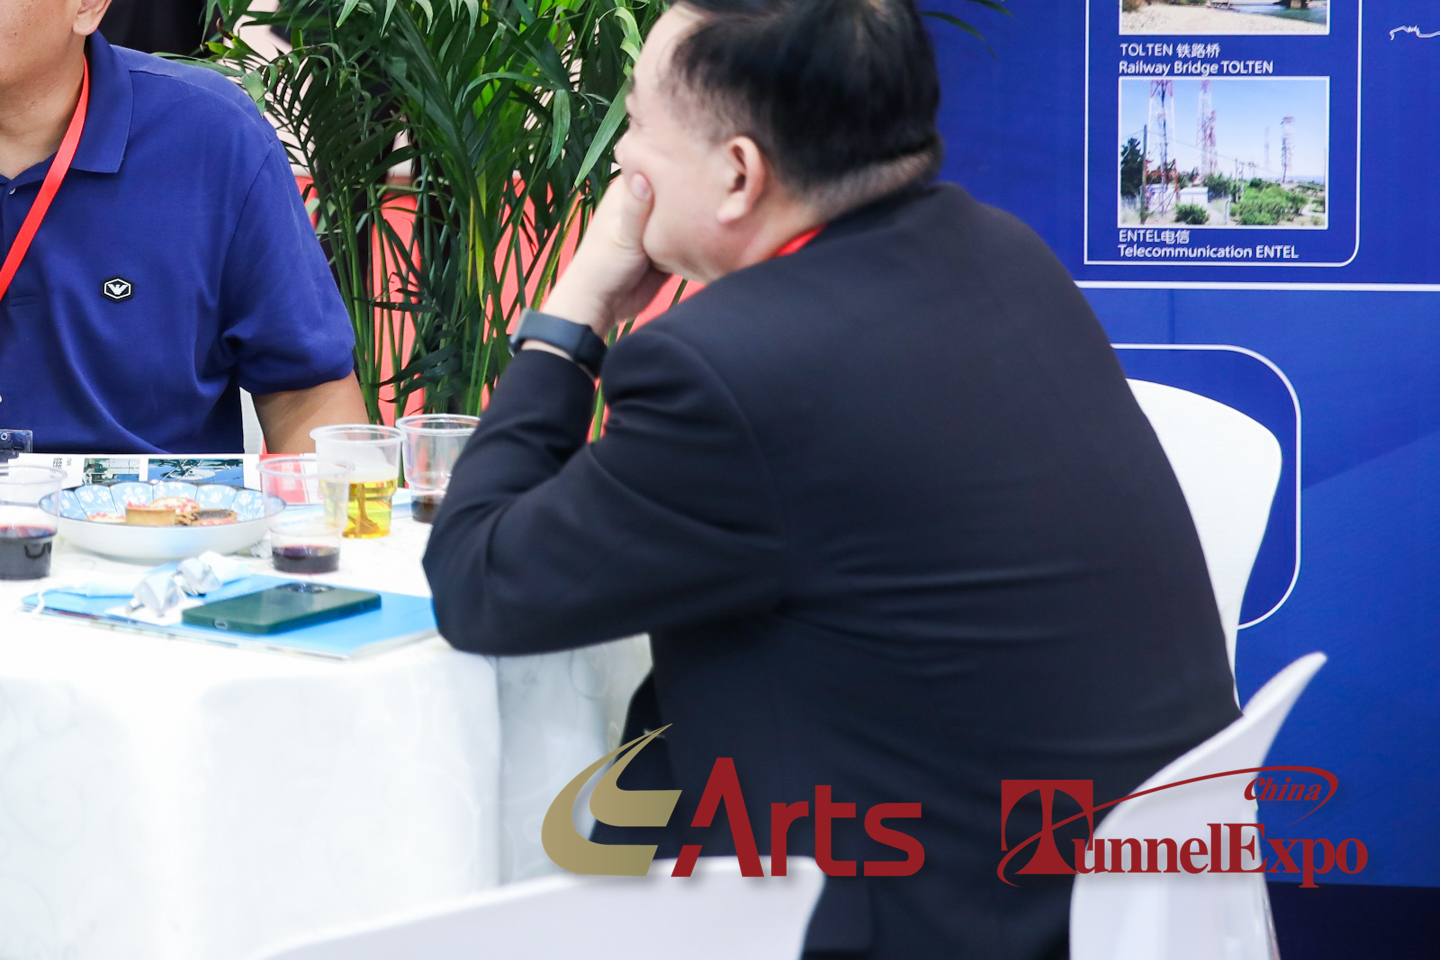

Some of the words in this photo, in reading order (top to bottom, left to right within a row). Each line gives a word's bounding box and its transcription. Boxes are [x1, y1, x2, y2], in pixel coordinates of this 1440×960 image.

[1119, 43, 1173, 57] TOLTEN
[1176, 42, 1221, 59] 铁路桥
[1119, 60, 1171, 76] Railway
[1174, 60, 1219, 77] Bridge
[1220, 60, 1274, 74] TOLTEN
[1119, 229, 1190, 245] ENTEL电信
[1117, 243, 1253, 259] Telecommunication
[1255, 245, 1300, 259] ENTEL
